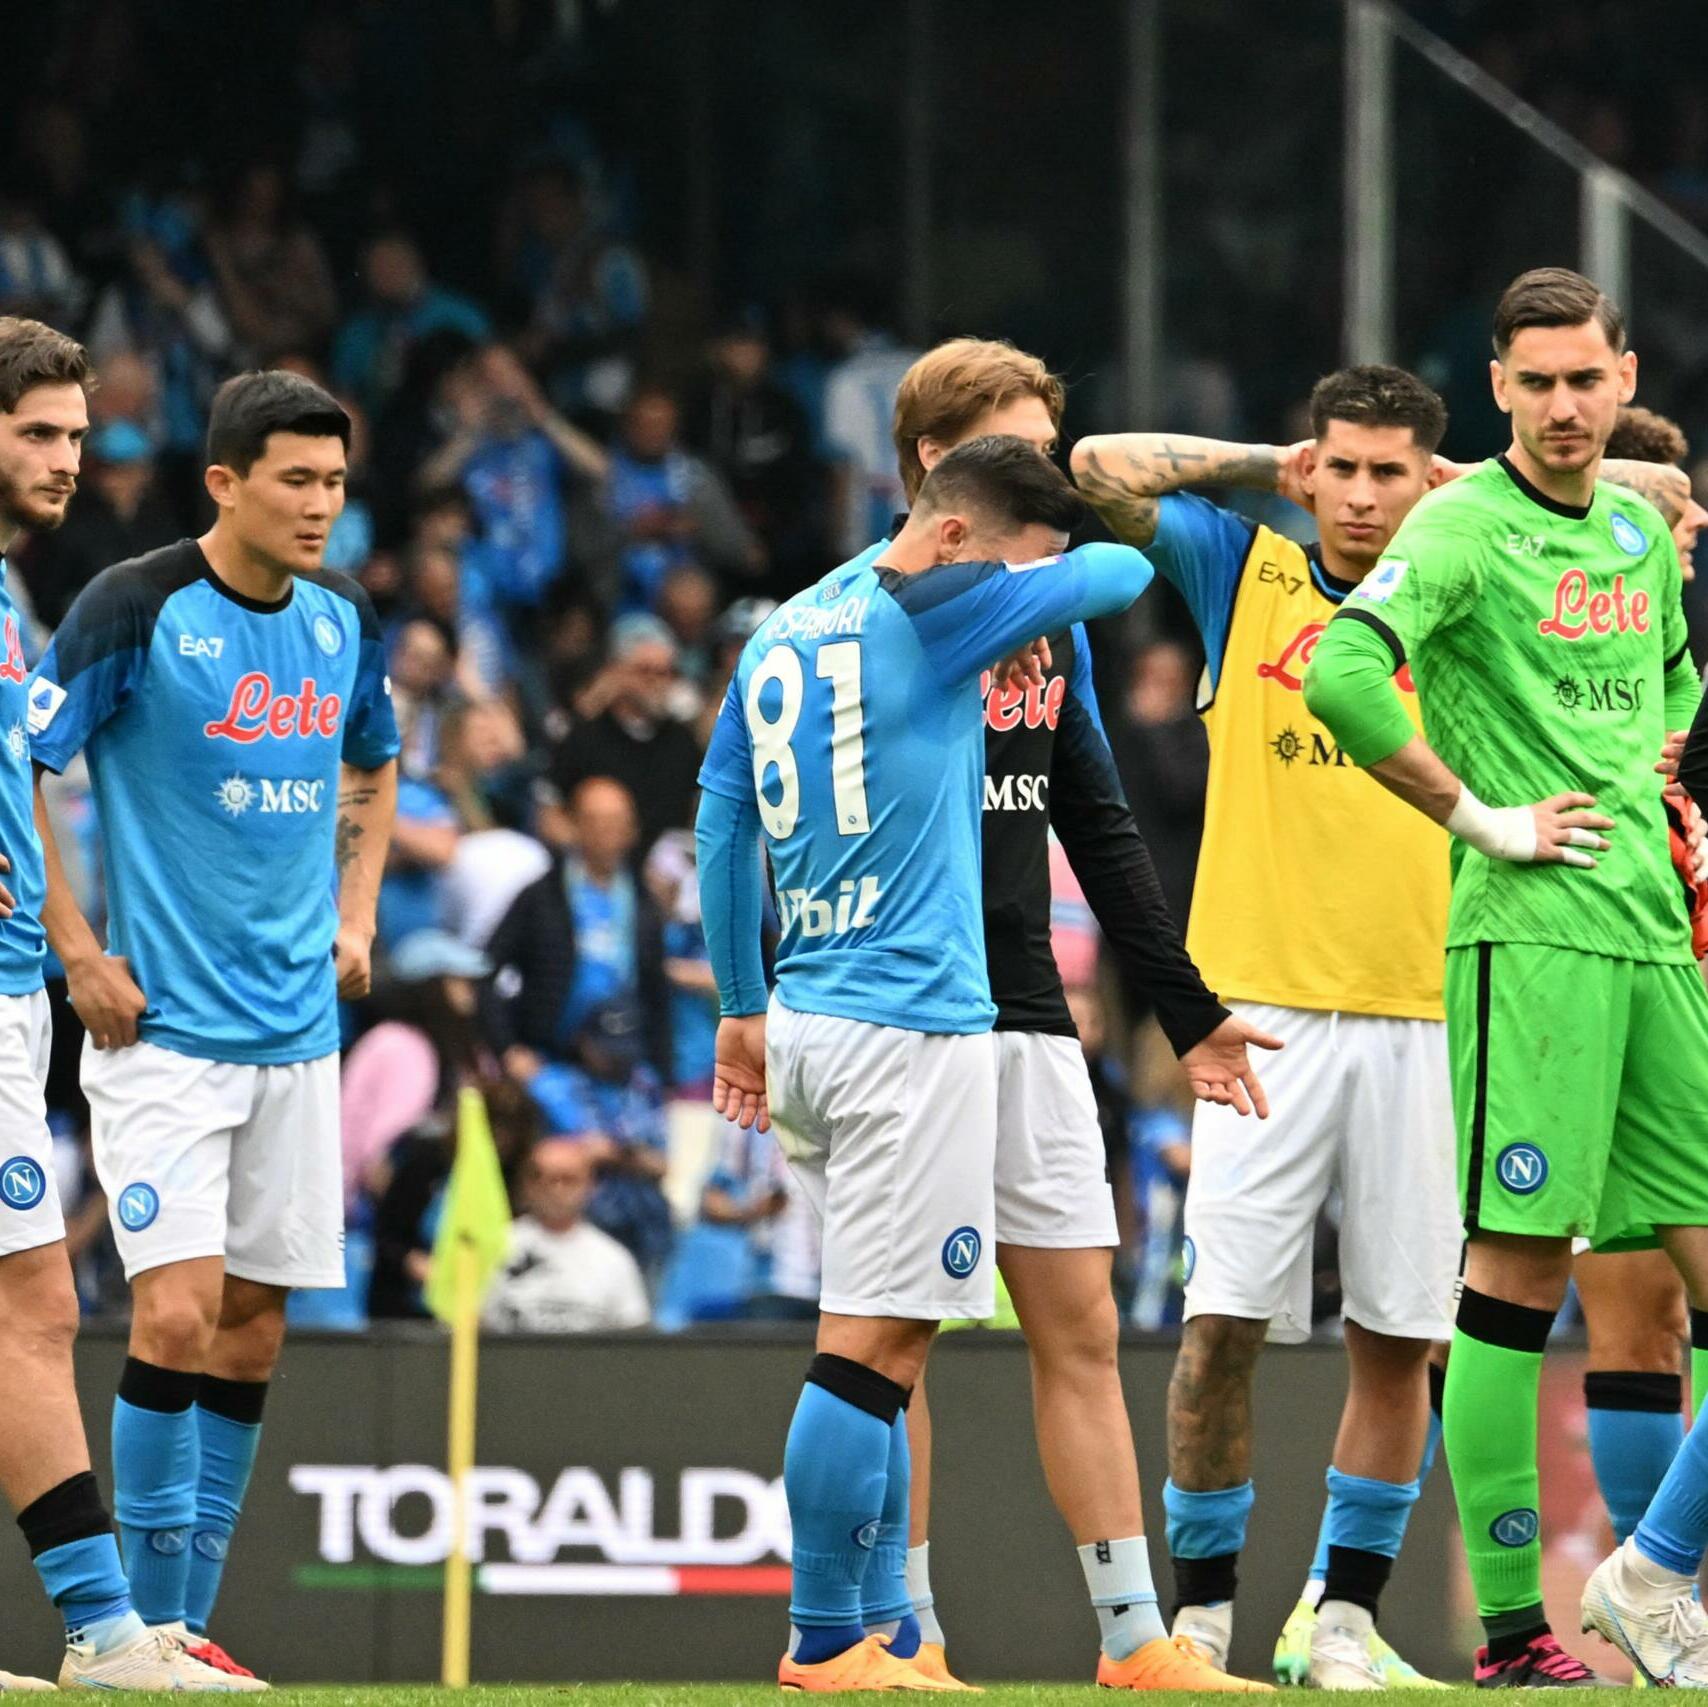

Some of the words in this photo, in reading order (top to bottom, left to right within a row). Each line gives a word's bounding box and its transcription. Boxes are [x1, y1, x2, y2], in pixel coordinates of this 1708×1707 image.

[1506, 534, 1546, 558] EA7
[1258, 561, 1305, 596] EA7
[1538, 568, 1650, 642] Lete
[179, 634, 225, 659] EA7
[204, 671, 342, 744] Lete
[980, 669, 1066, 732] ete
[746, 640, 871, 840] 81
[259, 779, 325, 814] MSC
[982, 774, 1049, 812] MSC
[9, 1168, 34, 1197] N
[1508, 1154, 1535, 1182] N
[126, 1191, 147, 1220] N
[953, 1239, 975, 1265] N
[289, 1463, 793, 1566] TORALD
